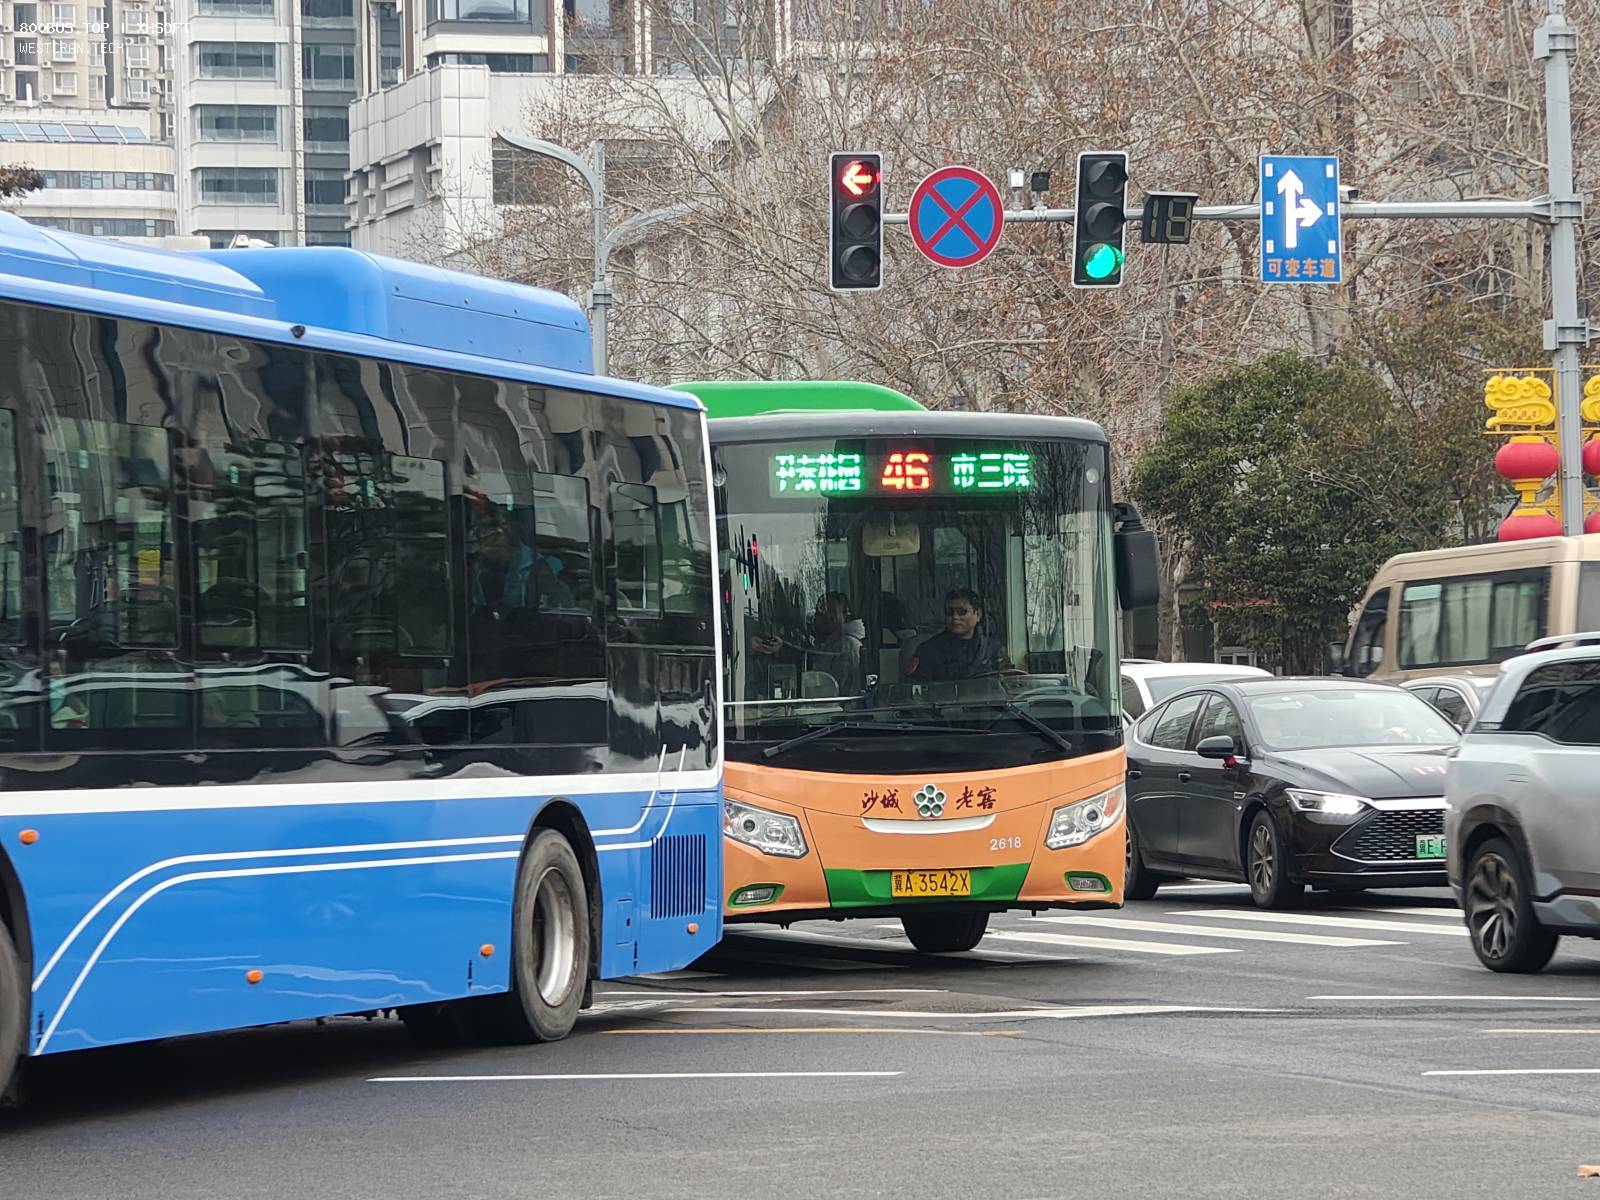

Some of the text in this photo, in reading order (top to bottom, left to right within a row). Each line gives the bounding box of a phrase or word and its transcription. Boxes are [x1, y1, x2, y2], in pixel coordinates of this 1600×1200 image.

[1266, 258, 1336, 278] 可变车道
[881, 453, 930, 490] 46
[951, 453, 1030, 488] 市三院
[860, 785, 998, 816] 沙城 老窖
[989, 836, 1022, 851] 2618
